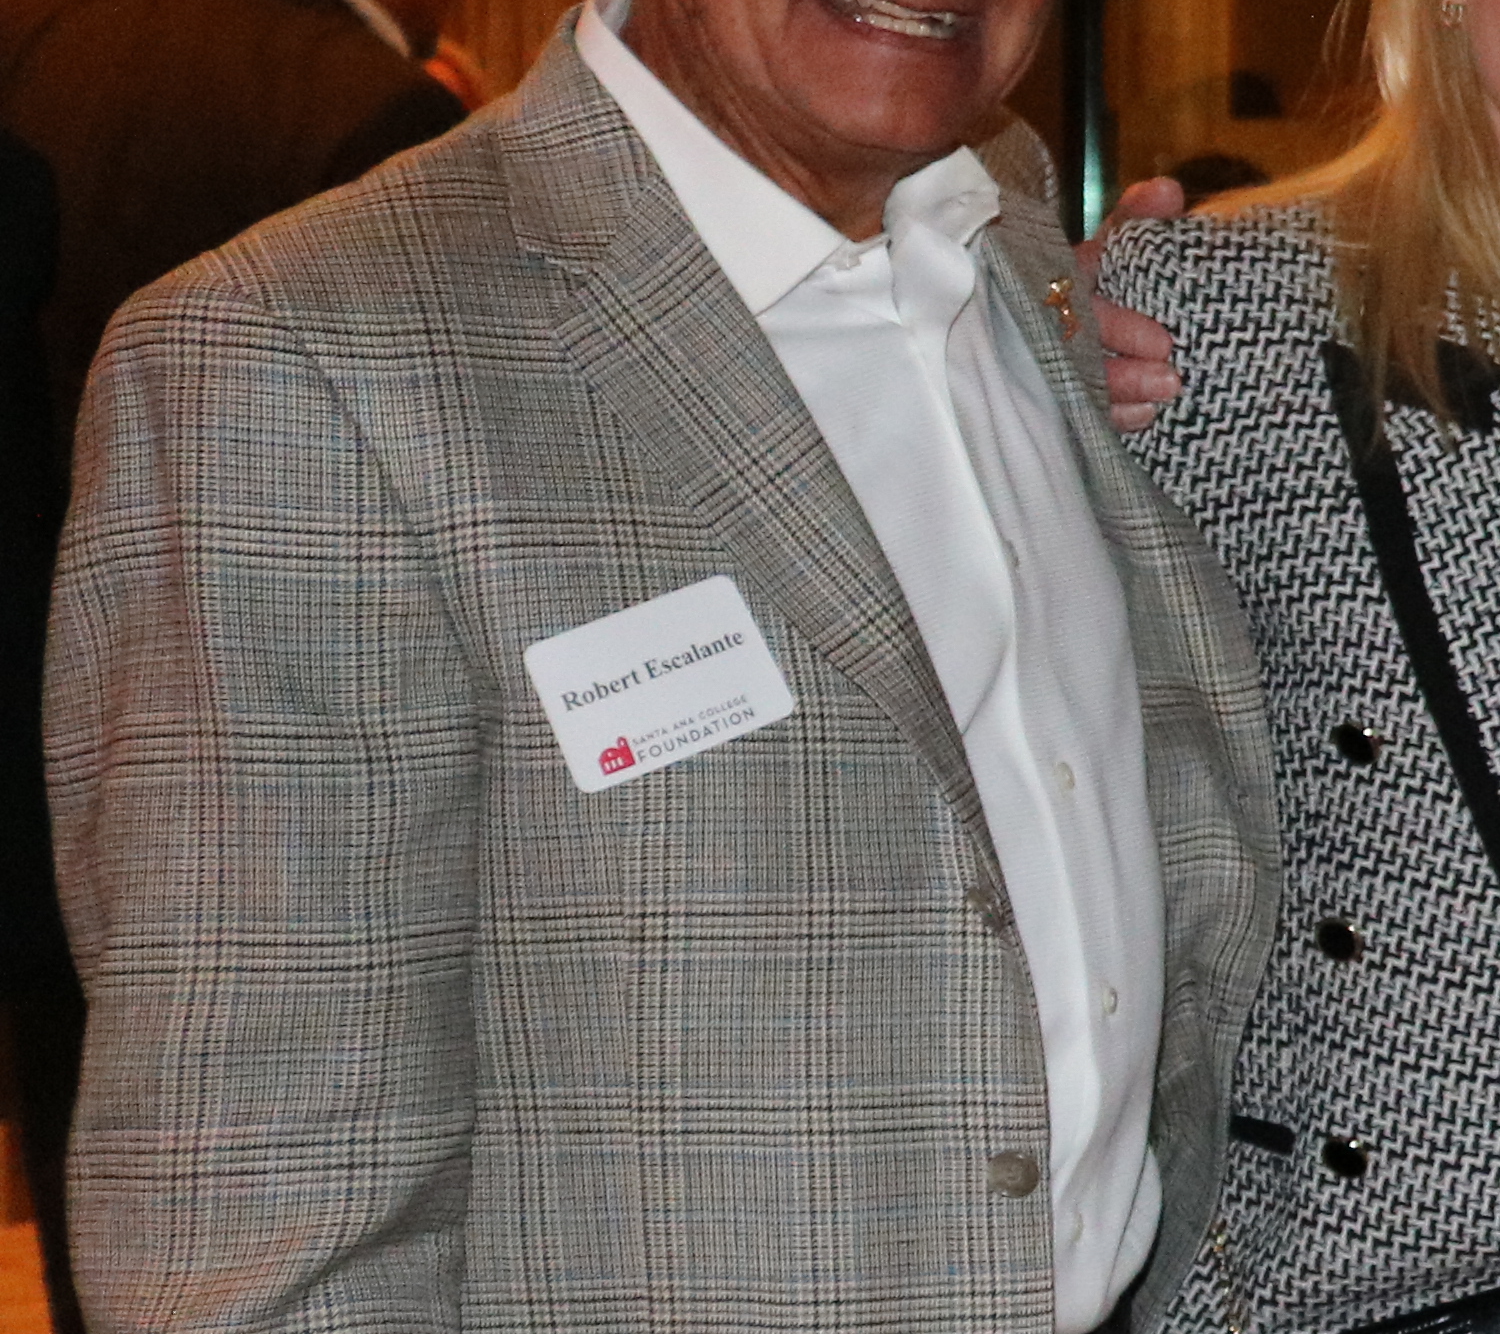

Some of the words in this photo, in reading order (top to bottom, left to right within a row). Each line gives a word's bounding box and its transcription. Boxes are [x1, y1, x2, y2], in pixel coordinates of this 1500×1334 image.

[561, 670, 642, 711] Robert
[643, 630, 745, 680] Escalante
[632, 727, 668, 746] SANTA
[673, 717, 694, 731] ANA
[698, 694, 748, 720] COLLEGE
[636, 707, 755, 763] FOUNDATION
